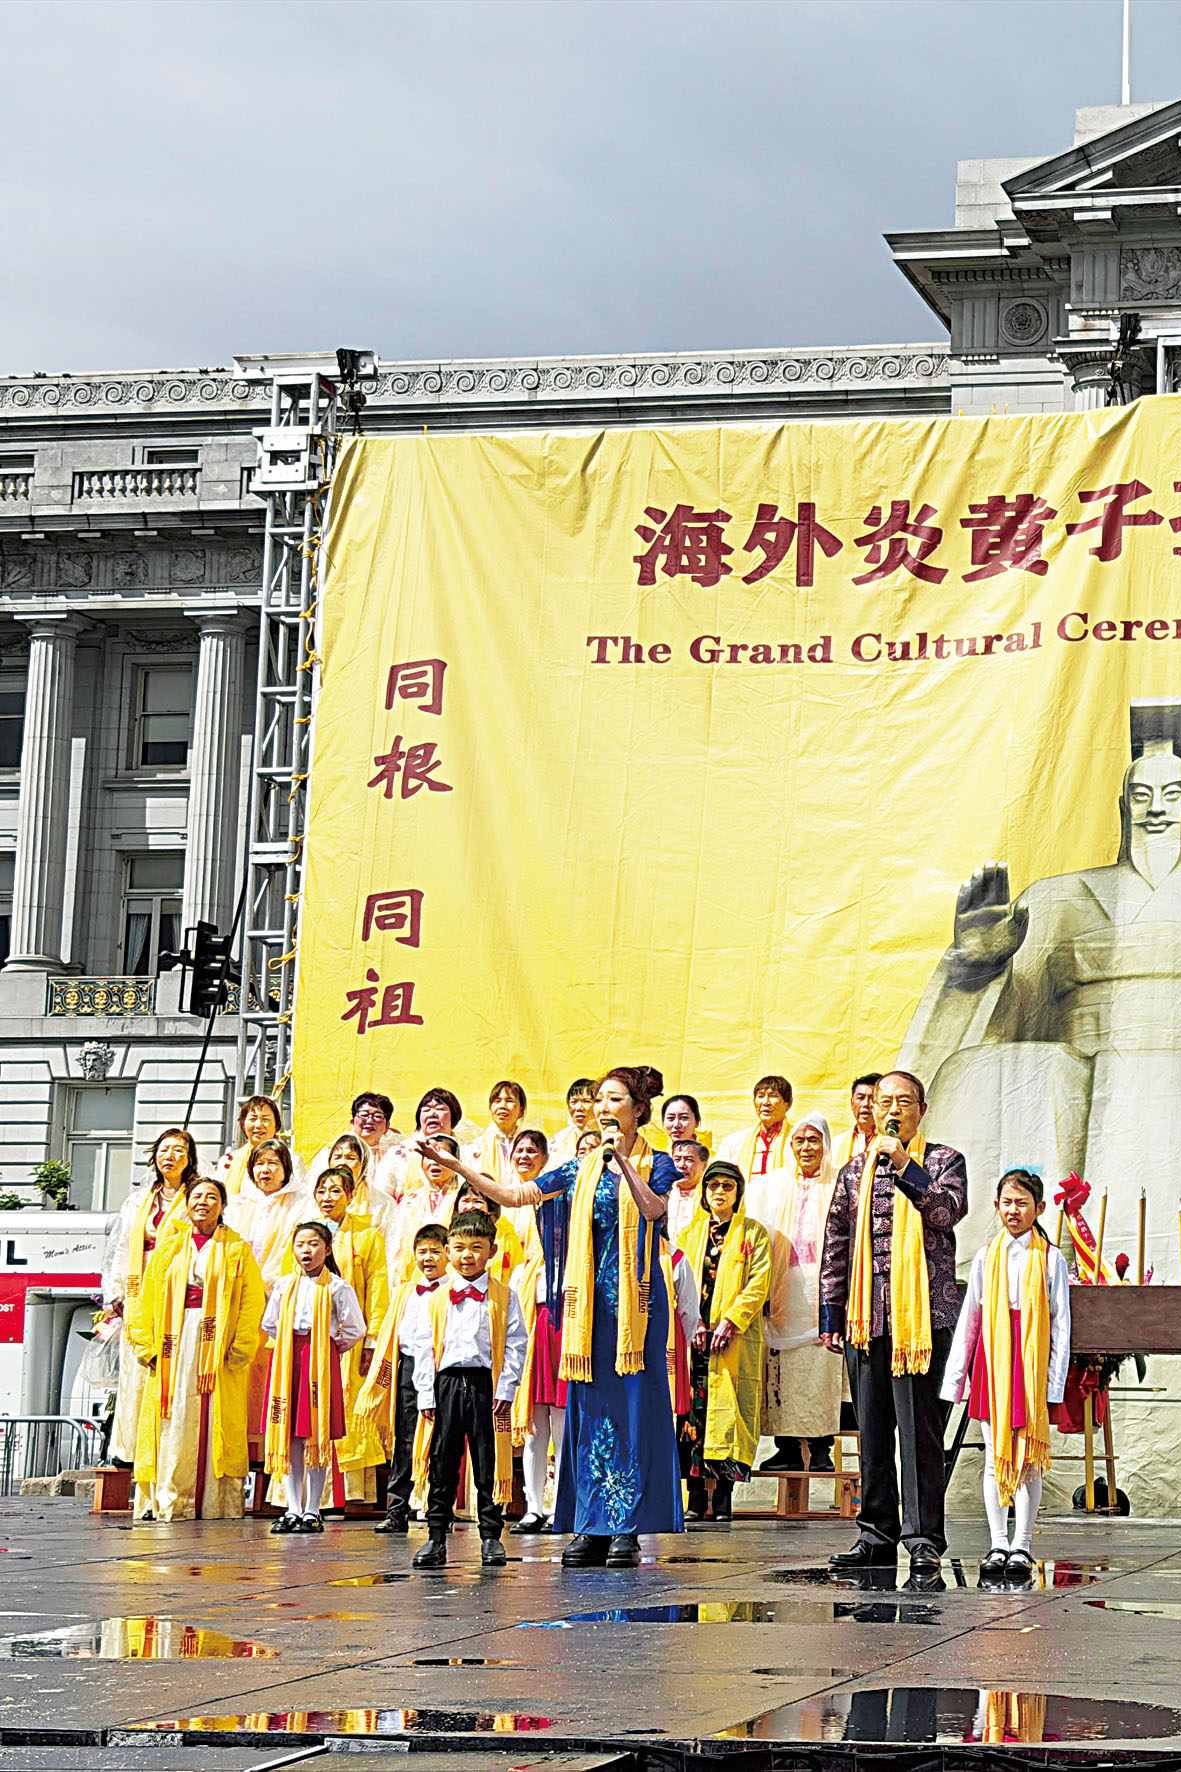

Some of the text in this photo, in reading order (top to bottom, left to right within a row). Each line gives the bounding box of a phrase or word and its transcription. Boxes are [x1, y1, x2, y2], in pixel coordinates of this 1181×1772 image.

[586, 635, 672, 665] The
[689, 635, 834, 665] Grand
[850, 621, 1043, 663] Cultural
[341, 658, 453, 1035] 同根 同祖
[0, 1240, 28, 1265] L
